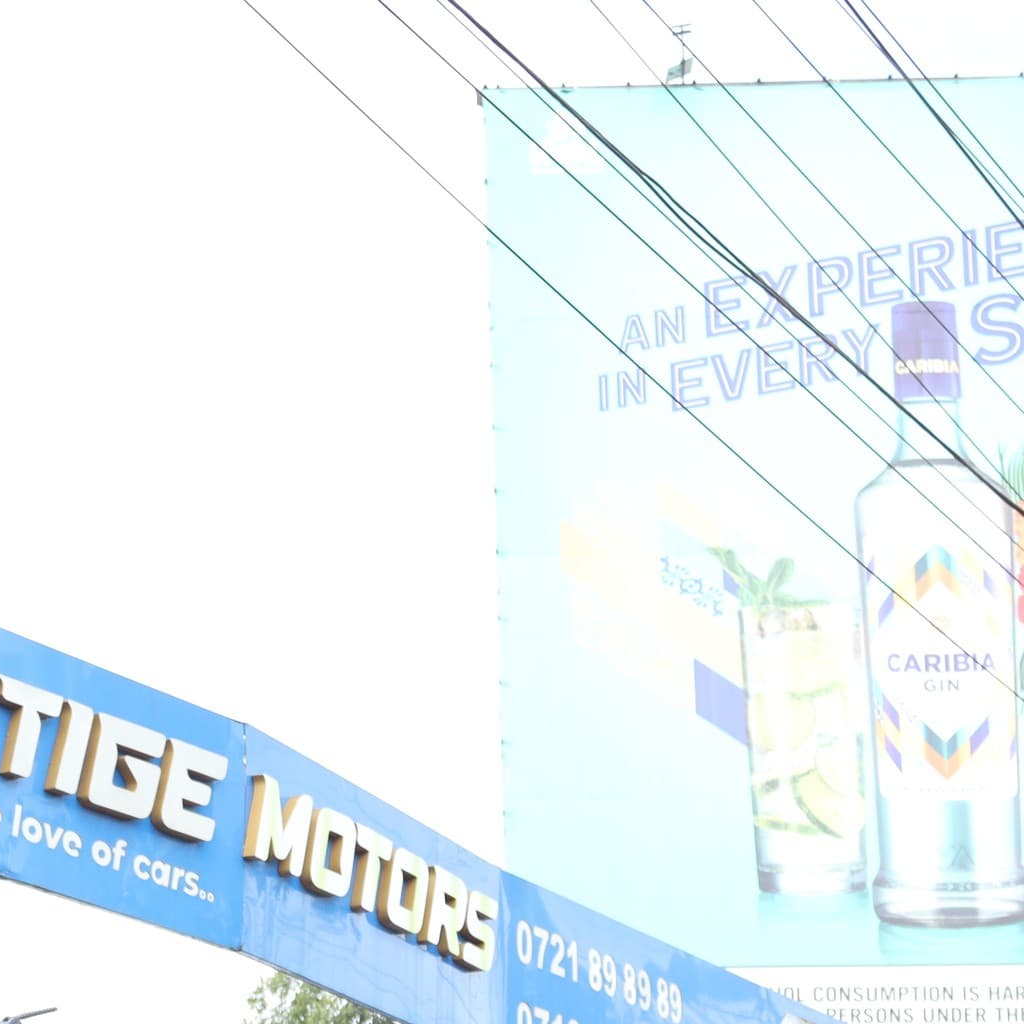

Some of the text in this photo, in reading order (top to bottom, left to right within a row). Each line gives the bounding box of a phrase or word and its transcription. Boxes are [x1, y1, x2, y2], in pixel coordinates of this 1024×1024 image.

[619, 305, 686, 353] AN
[598, 368, 648, 412] IN
[670, 323, 880, 412] EVERY
[895, 358, 960, 375] CARIBIA
[887, 653, 996, 673] CARIBIA
[924, 679, 961, 693] GIN
[12, 804, 82, 857] love
[91, 839, 129, 872] of
[243, 773, 499, 973] MOTORS
[516, 920, 682, 1024] 0721 89 89 89
[813, 985, 954, 1002] CONSUMPTION
[962, 985, 980, 1002] IS
[826, 1007, 914, 1024] PERSONS
[923, 1007, 987, 1024] UNDER
